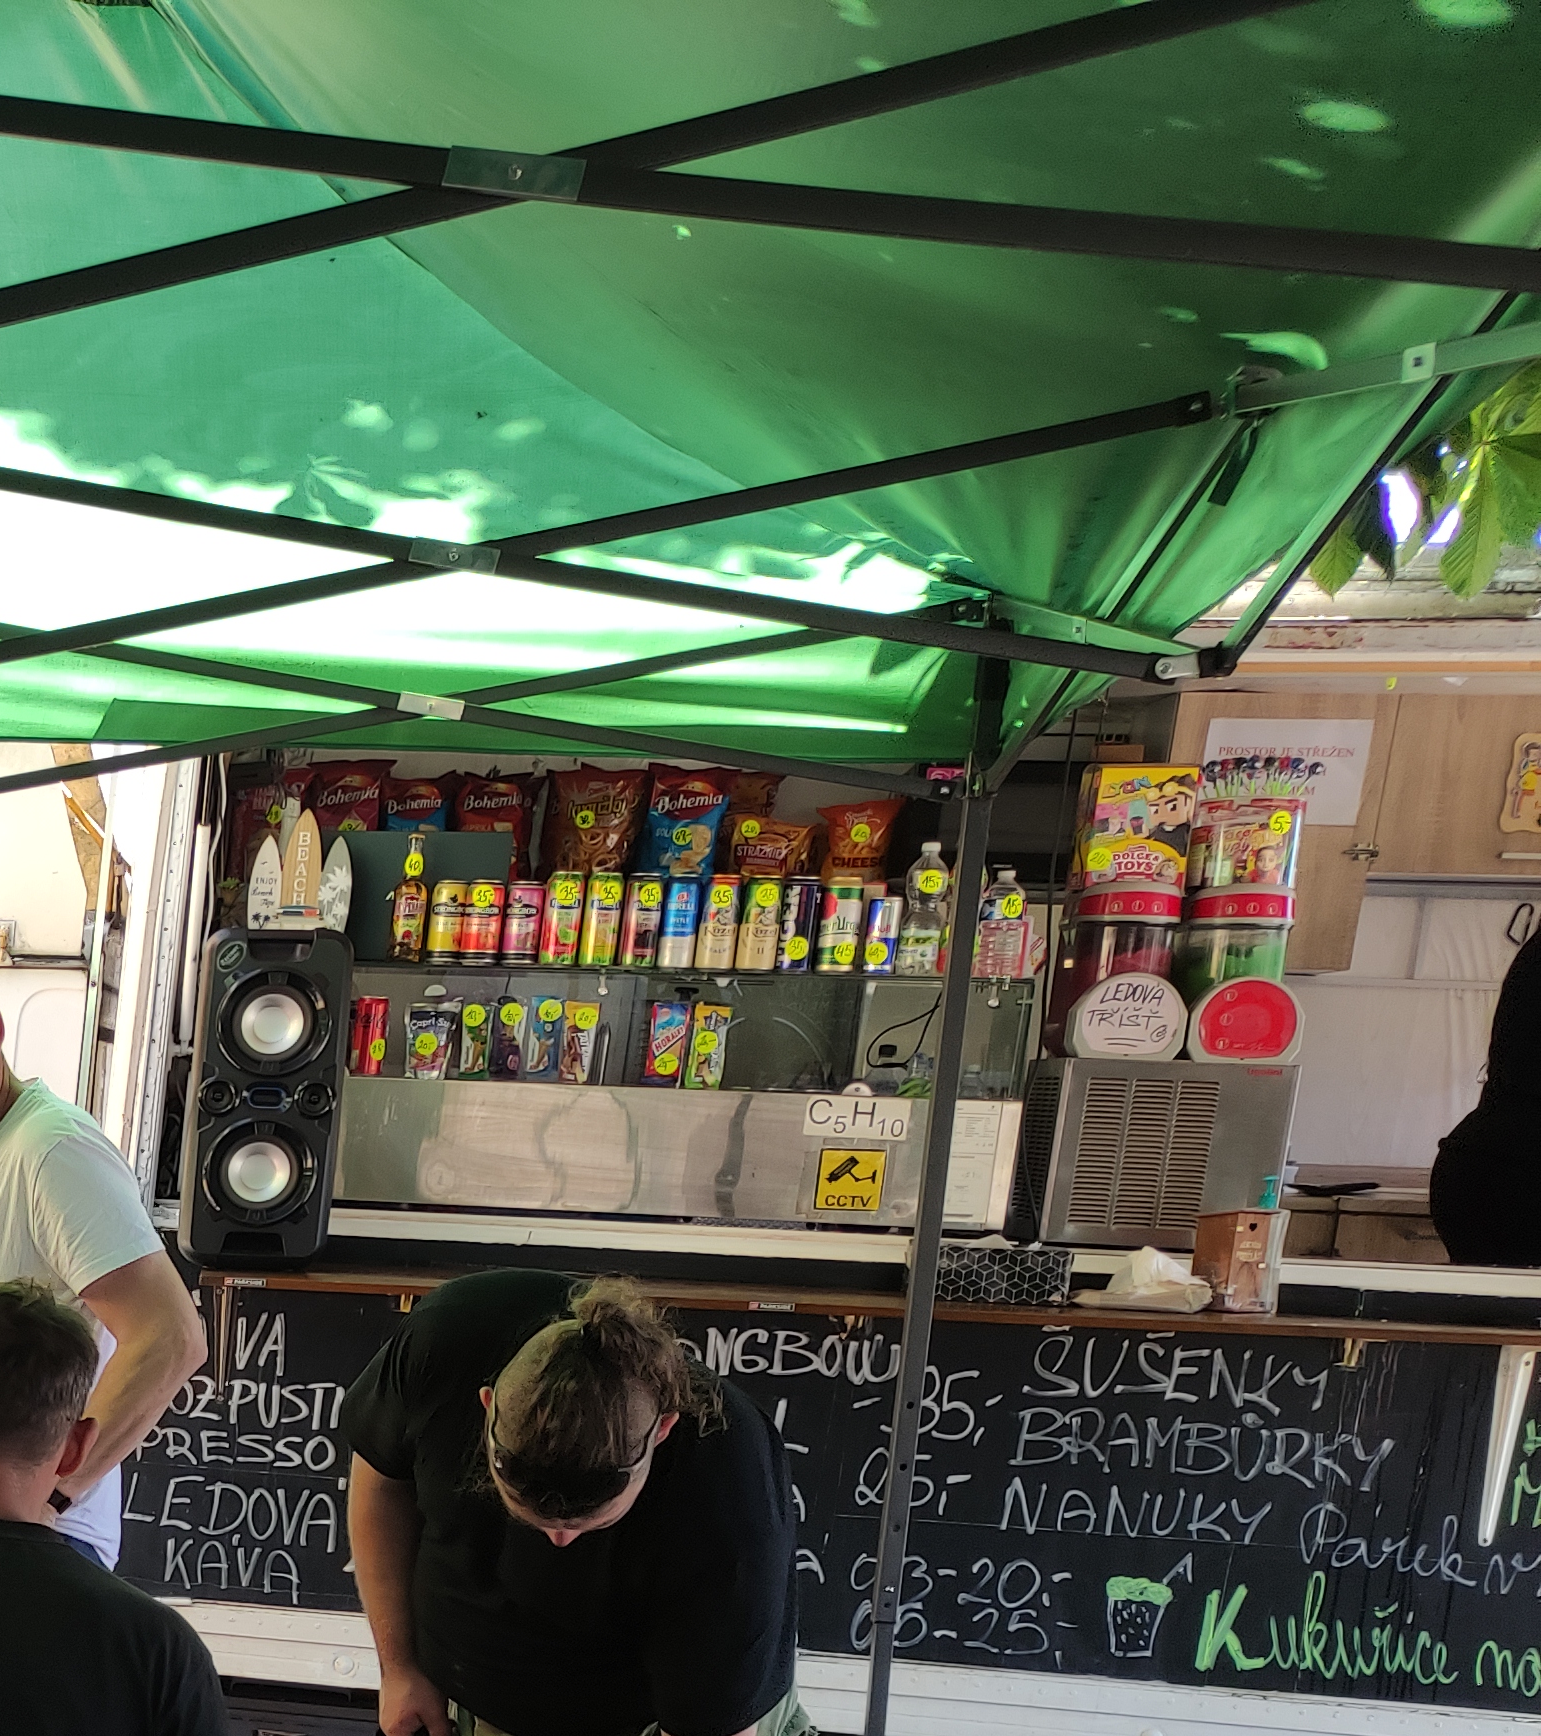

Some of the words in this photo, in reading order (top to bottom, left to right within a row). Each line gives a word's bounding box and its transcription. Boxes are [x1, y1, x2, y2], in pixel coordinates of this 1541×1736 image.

[1219, 746, 1276, 756] PROSTOR
[1281, 747, 1295, 757] JE
[319, 786, 379, 807] Bohemia
[387, 795, 443, 814] Bohemia
[464, 792, 523, 811] Bohemia
[655, 793, 724, 813] Bohemia
[293, 831, 312, 906] BEACH
[831, 857, 880, 868] CHEES
[1116, 861, 1154, 872] TOYS
[256, 877, 277, 885] ENJOY
[1100, 982, 1165, 1006] LEDOVÁ
[410, 1016, 436, 1031] Capri
[1086, 1006, 1164, 1030] TŘÍŠŤ
[824, 1194, 872, 1208] CCTV
[999, 1476, 1273, 1545] NANUKY
